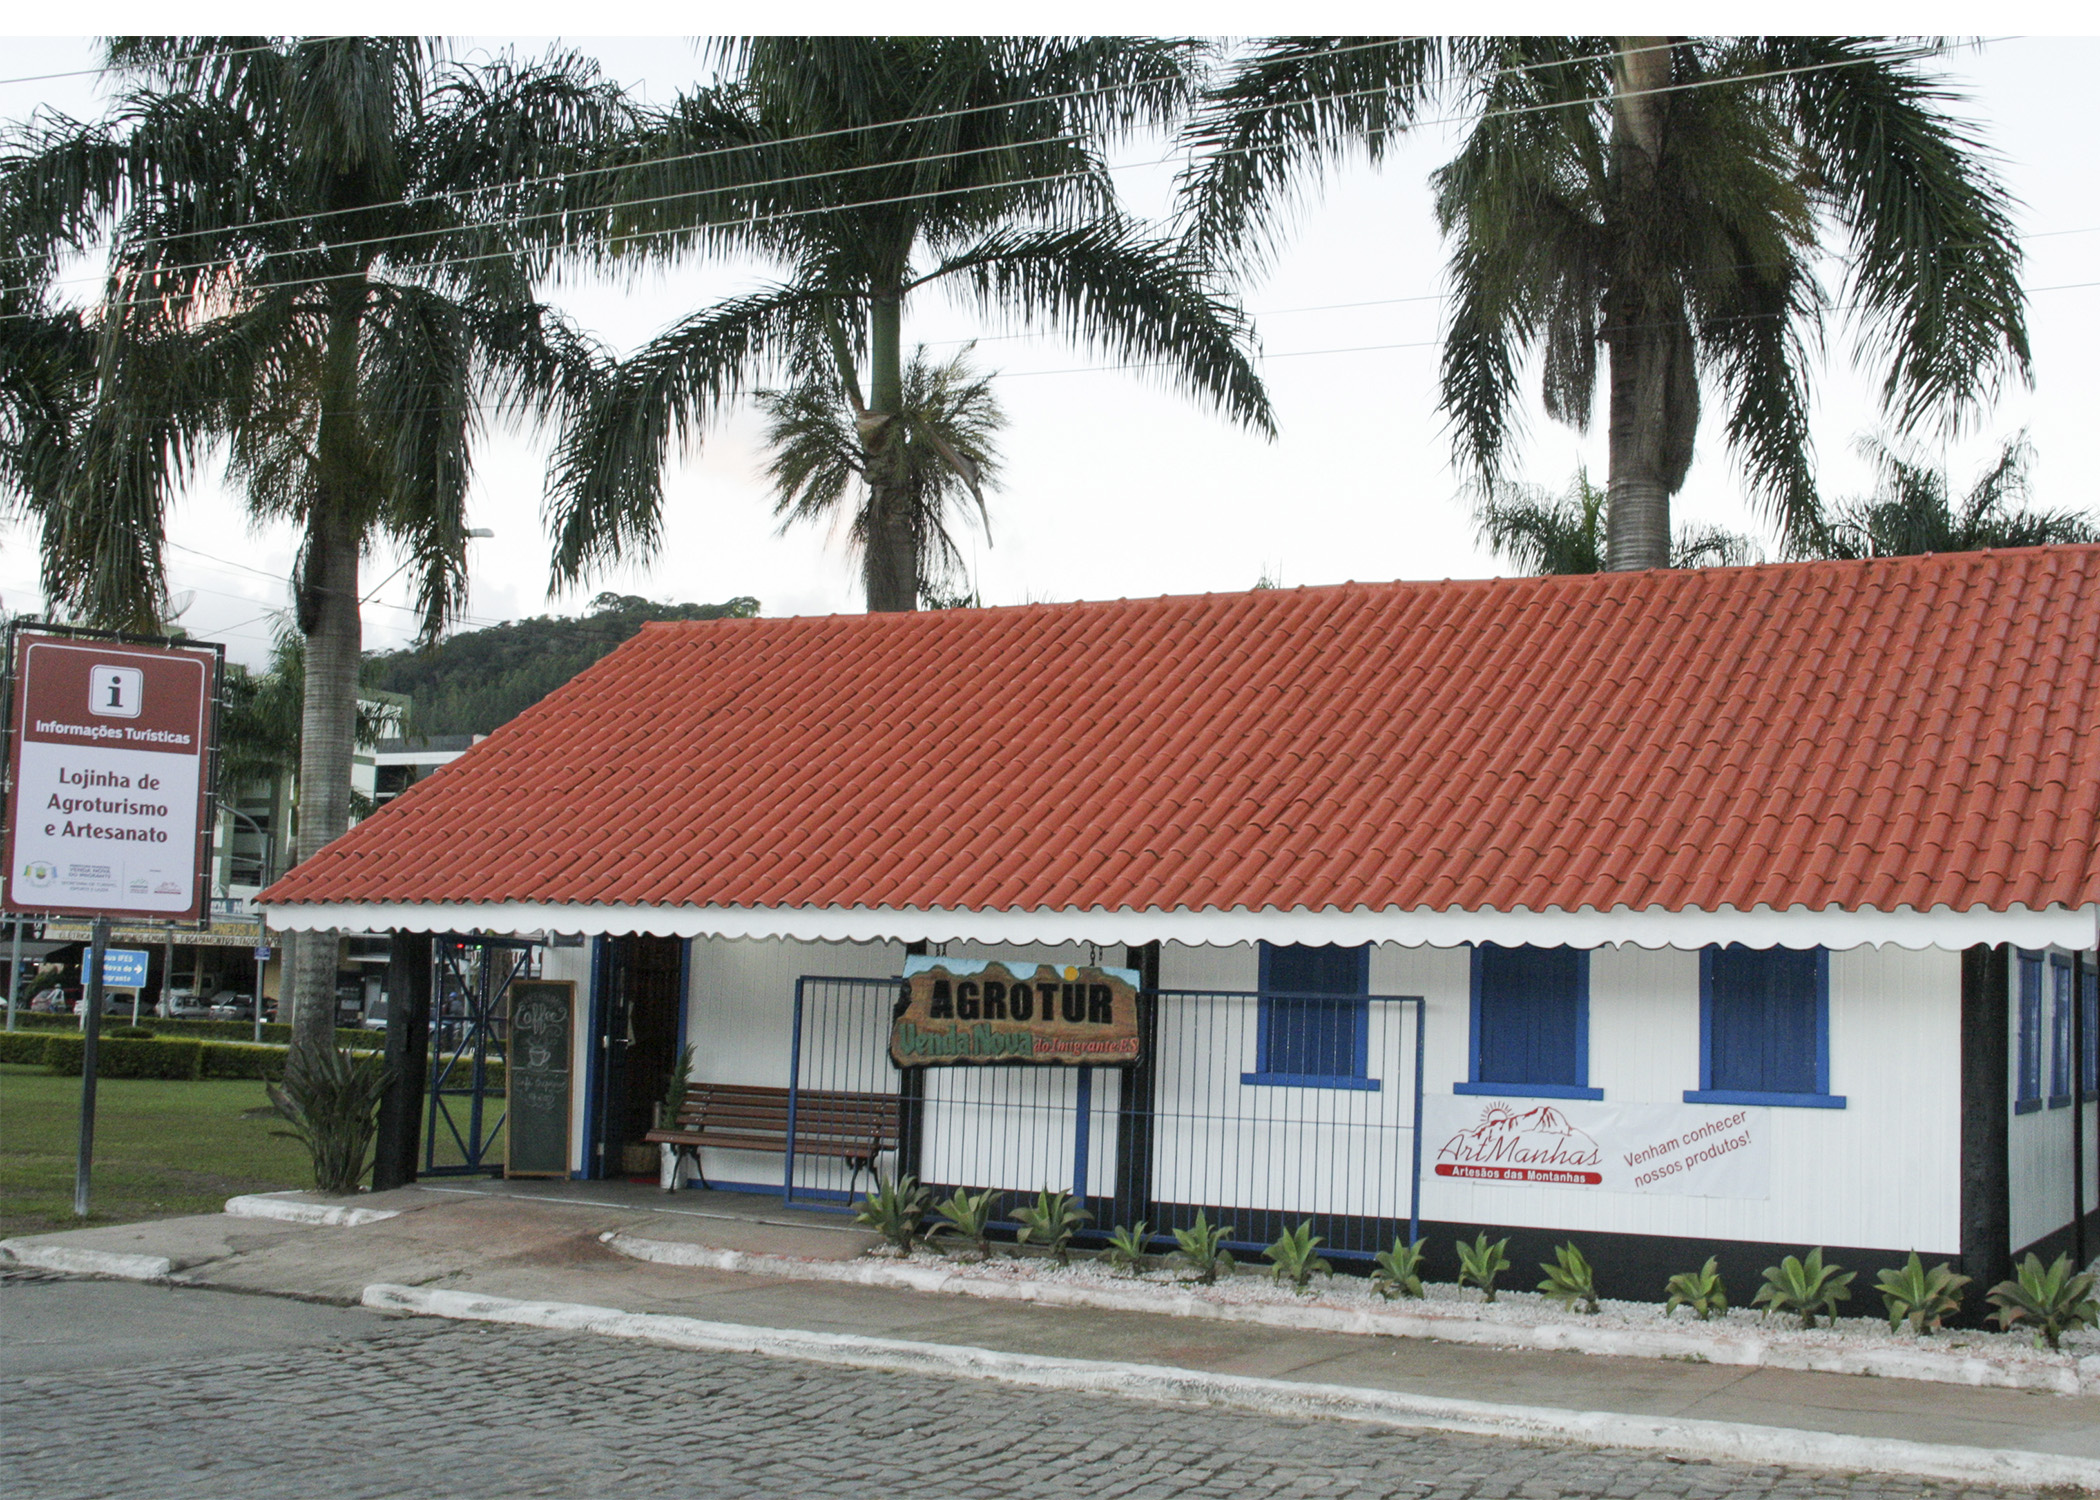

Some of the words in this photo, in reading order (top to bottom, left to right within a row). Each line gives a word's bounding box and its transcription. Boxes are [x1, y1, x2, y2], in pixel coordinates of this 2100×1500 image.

[35, 720, 122, 740] Informações
[124, 727, 191, 744] Turísticas
[59, 767, 130, 789] Lojinha
[137, 773, 160, 790] de
[46, 793, 168, 817] Agroturismo
[44, 823, 56, 836] e
[61, 820, 168, 843] Artesanato
[930, 979, 1113, 1024] AGROTUR
[899, 1022, 971, 1056] Venda
[972, 1023, 1034, 1056] Nova
[1034, 1038, 1050, 1053] do
[1437, 1133, 1603, 1166] ArtManhas
[1623, 1139, 1680, 1168] Venham
[1682, 1110, 1748, 1146] conhecer
[1635, 1161, 1683, 1188] nossos
[1685, 1129, 1753, 1172] produtos!
[1452, 1165, 1500, 1178] Artesãos
[1503, 1168, 1524, 1180] das
[1527, 1169, 1587, 1184] Montanhas
